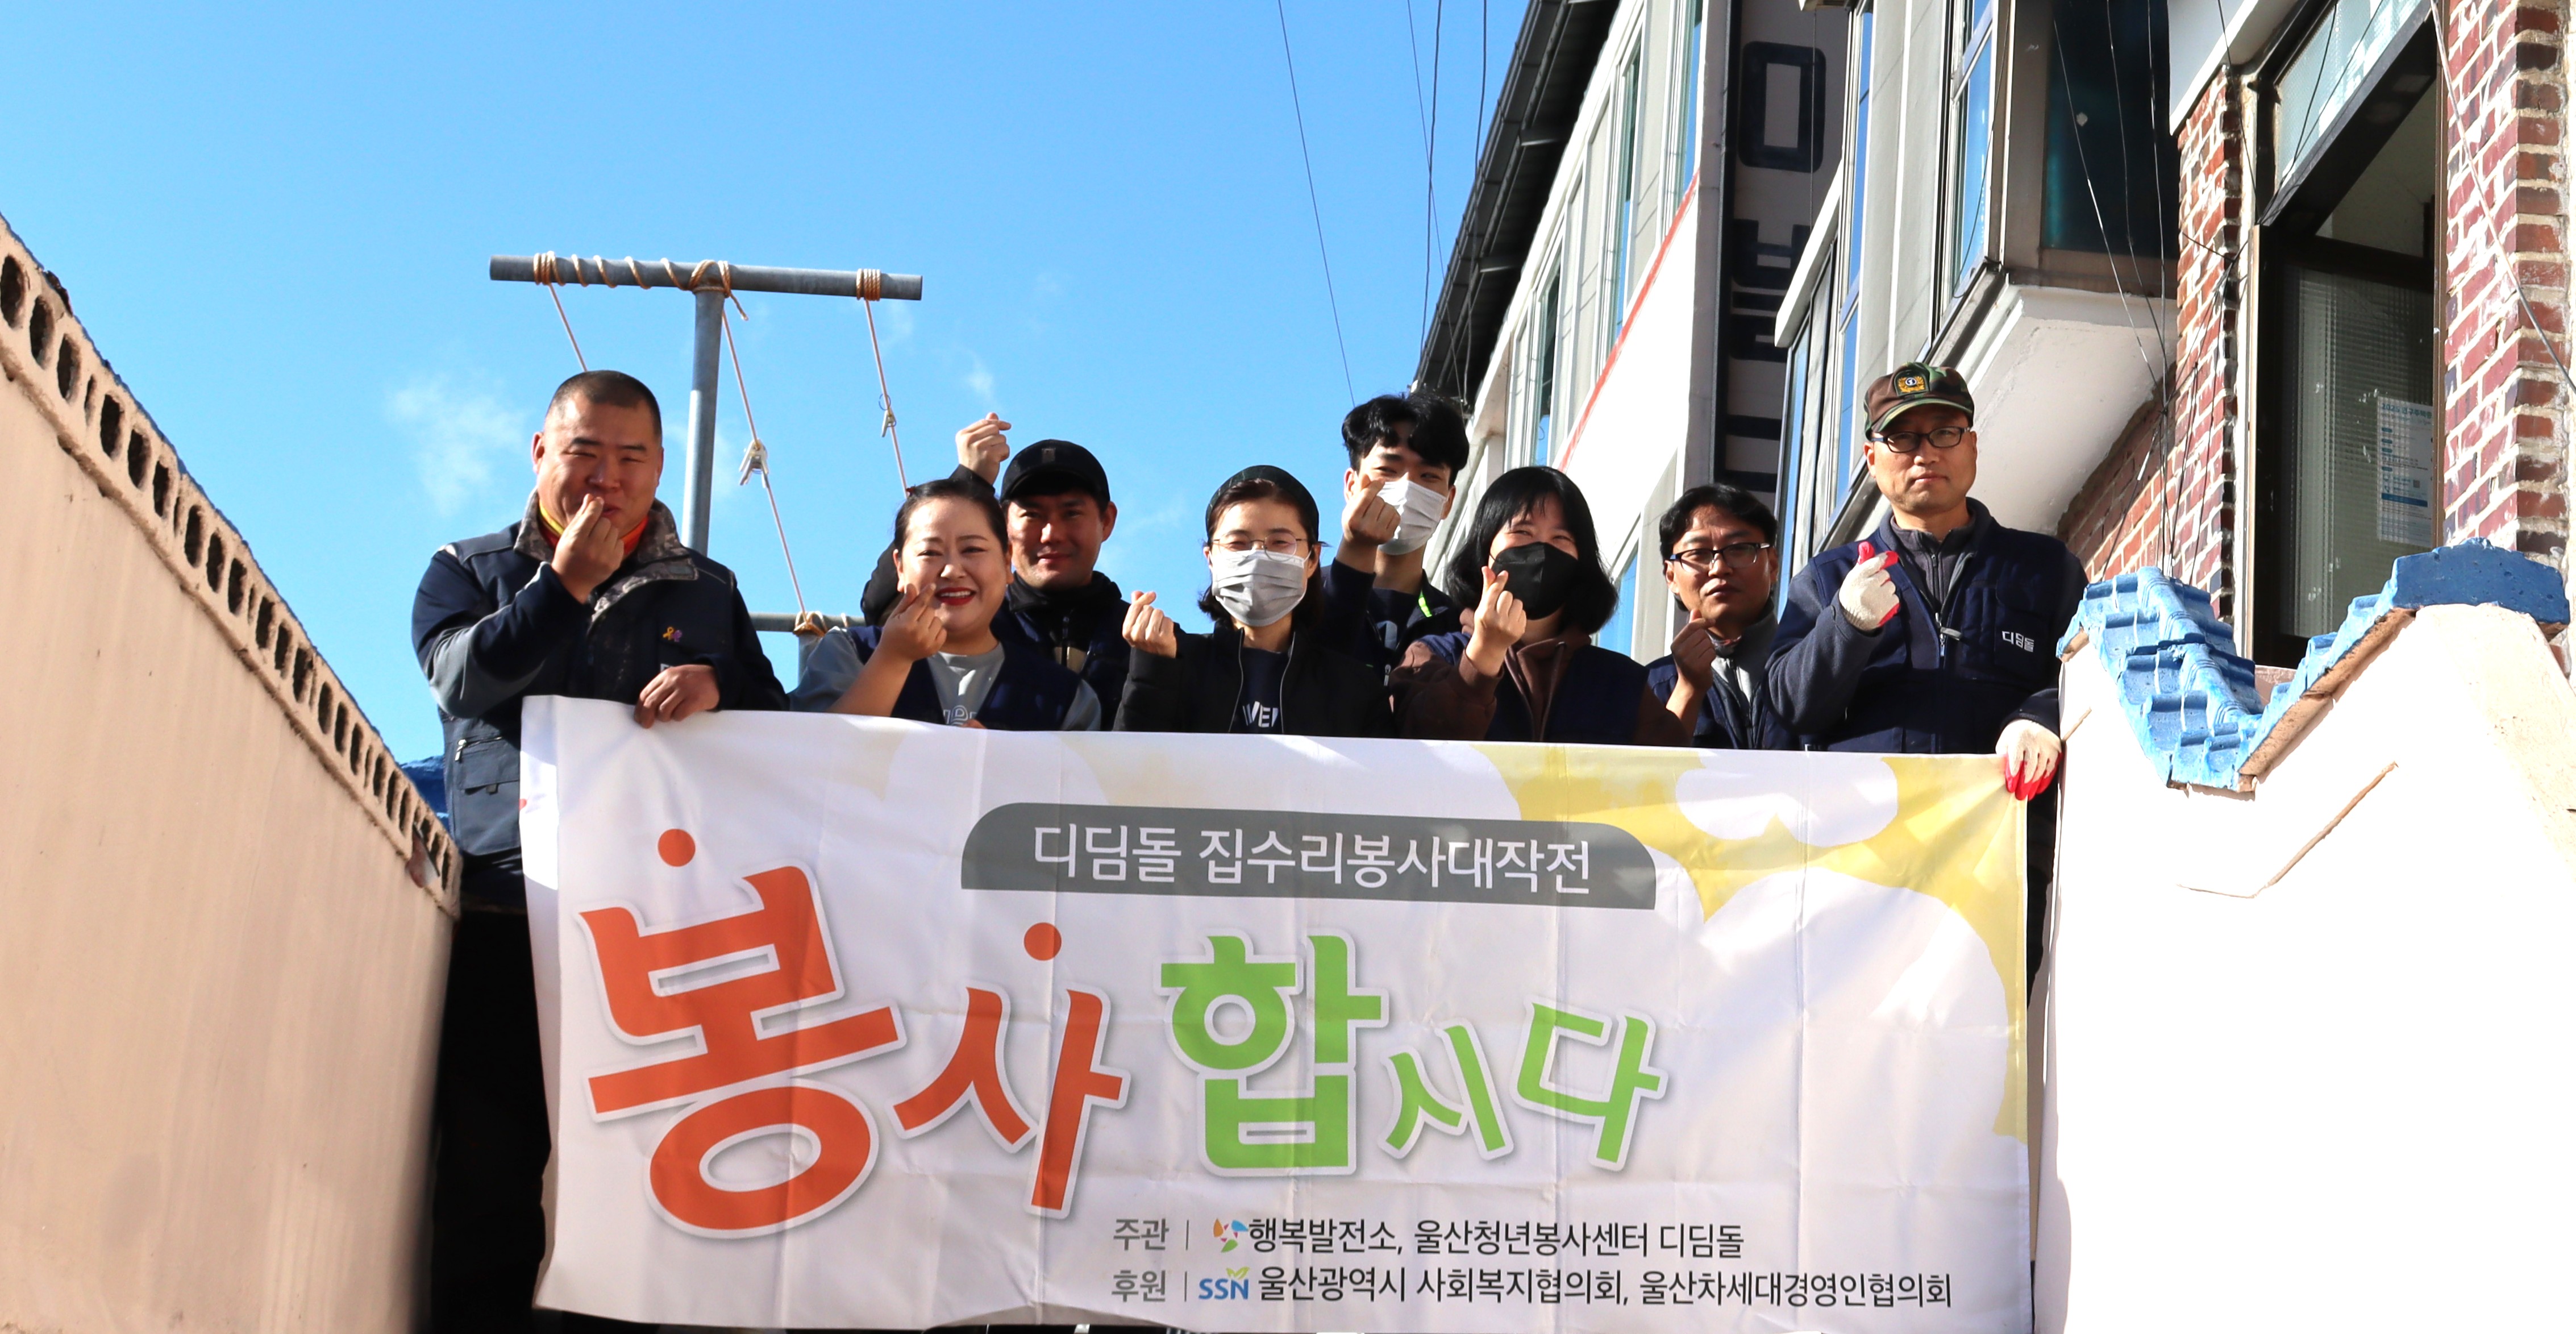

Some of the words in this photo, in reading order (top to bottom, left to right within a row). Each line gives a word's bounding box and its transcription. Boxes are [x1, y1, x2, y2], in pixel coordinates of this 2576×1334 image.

[2001, 630, 2034, 653] 디딤돌
[1034, 823, 1181, 883] 디딤돌
[1198, 828, 1591, 894] 집수리봉사대작전
[1113, 1218, 1170, 1251] 주관
[1250, 1218, 1403, 1254] 행복발전소,
[1414, 1220, 1647, 1257] 울산청년봉사센터
[1660, 1223, 1744, 1258] 디딤돌
[1111, 1269, 1166, 1303] 후원
[1198, 1278, 1249, 1300] SSN
[1258, 1266, 1405, 1302] 울산광역시
[1416, 1267, 1629, 1306] 사회복지협의회,
[1639, 1270, 1951, 1308] 울산차세대경영인협의회
